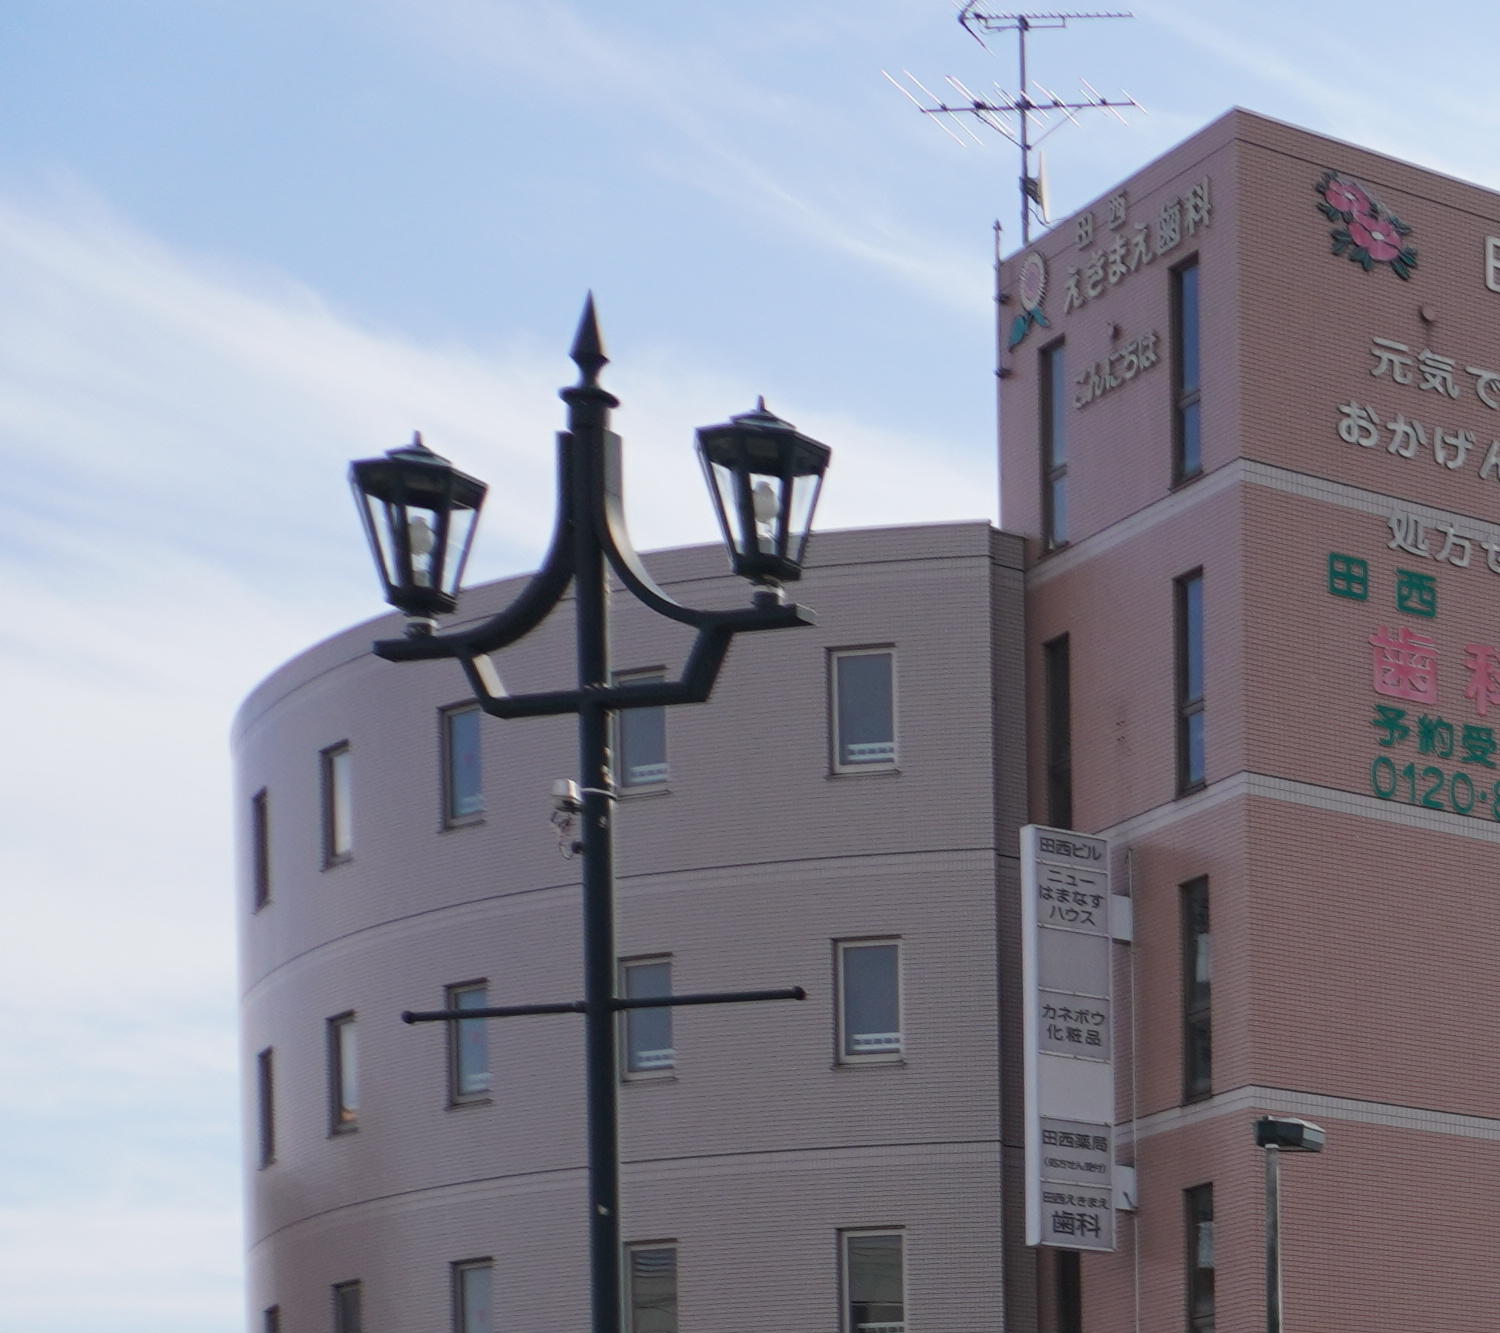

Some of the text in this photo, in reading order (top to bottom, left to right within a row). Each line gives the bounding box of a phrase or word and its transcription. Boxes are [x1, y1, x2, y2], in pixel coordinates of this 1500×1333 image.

[1074, 330, 1159, 410] こんにちは
[1327, 552, 1439, 620] 田西
[1039, 838, 1103, 862] 田西ビル
[1047, 869, 1096, 886] ニュー
[1039, 884, 1105, 910] はまなす
[1049, 904, 1097, 926] ハウス
[1042, 1004, 1106, 1026] カネボウ
[1047, 1024, 1103, 1047] 化粧品
[1042, 1129, 1108, 1153] 田西薬局
[1052, 1210, 1101, 1239] 歯科
